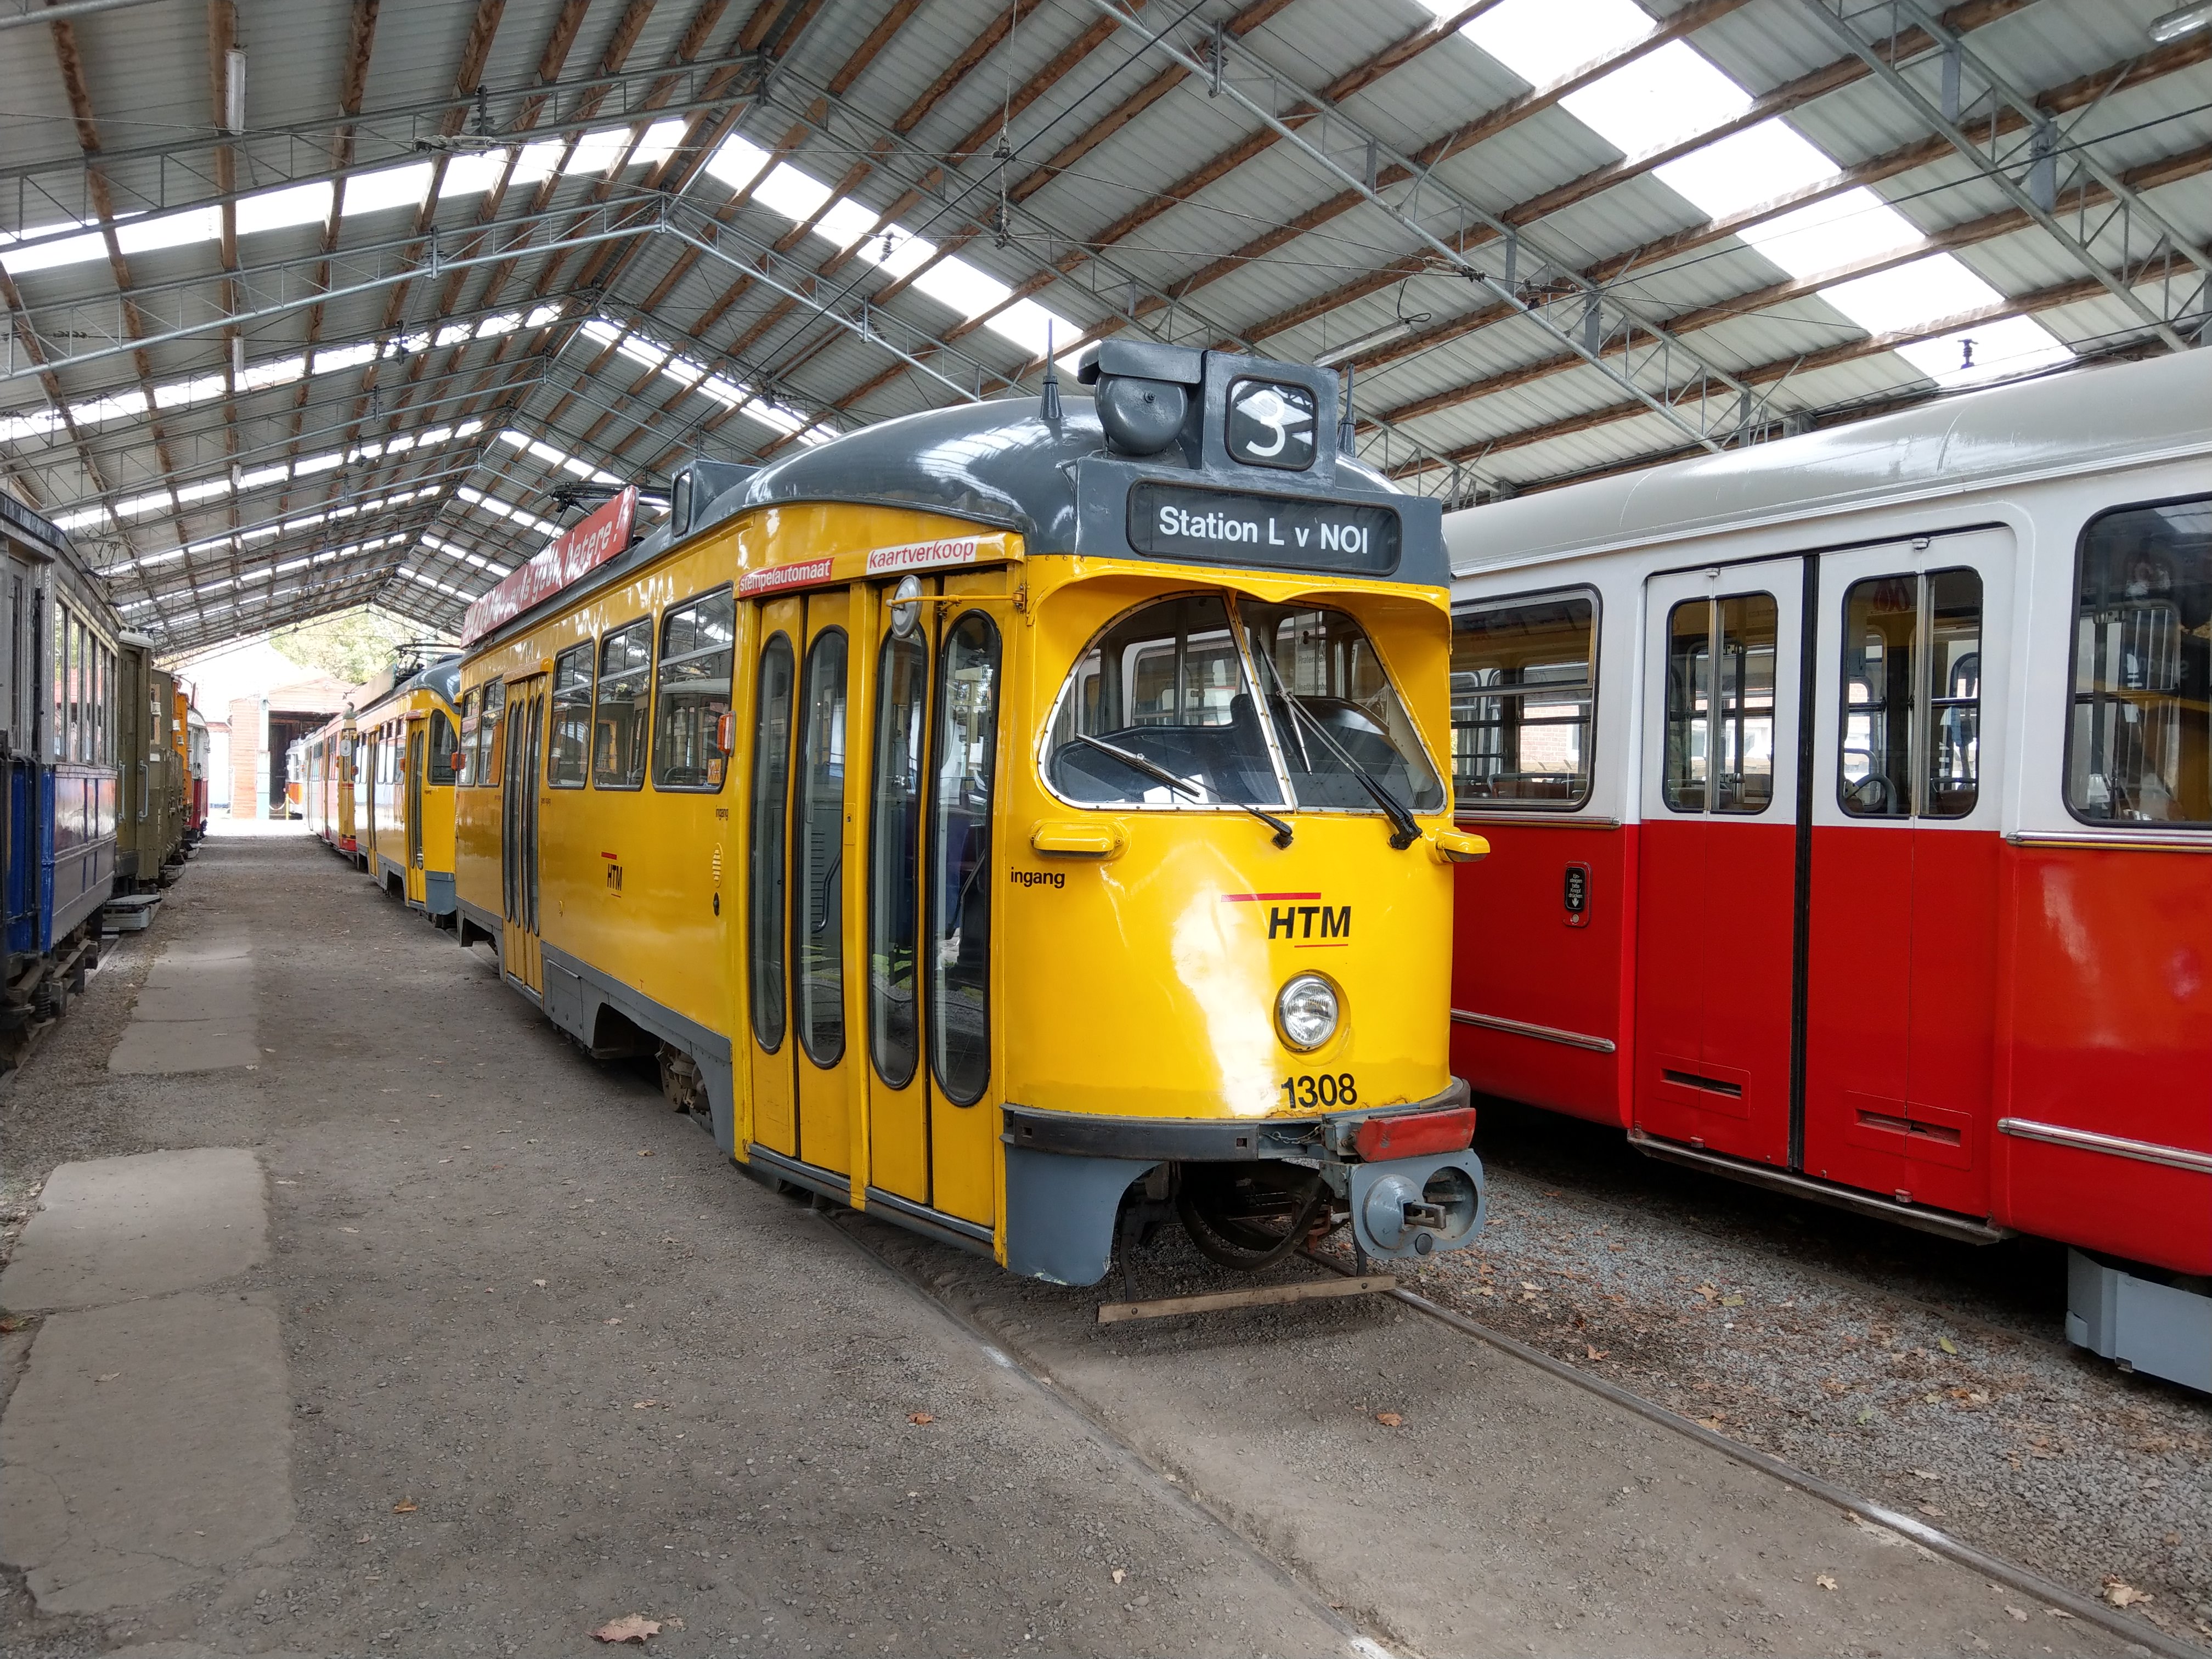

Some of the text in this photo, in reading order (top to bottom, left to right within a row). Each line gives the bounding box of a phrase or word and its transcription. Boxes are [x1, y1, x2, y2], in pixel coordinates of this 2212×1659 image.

[1246, 390, 1285, 456] 3
[1159, 506, 1368, 554] Station L v NOI
[869, 540, 974, 568] kaartverkoop
[740, 558, 831, 591] stempelautomaat
[607, 864, 622, 891] HTM
[1011, 867, 1065, 888] ingang
[1268, 906, 1351, 939] HTM
[1282, 1073, 1358, 1109] 1308
